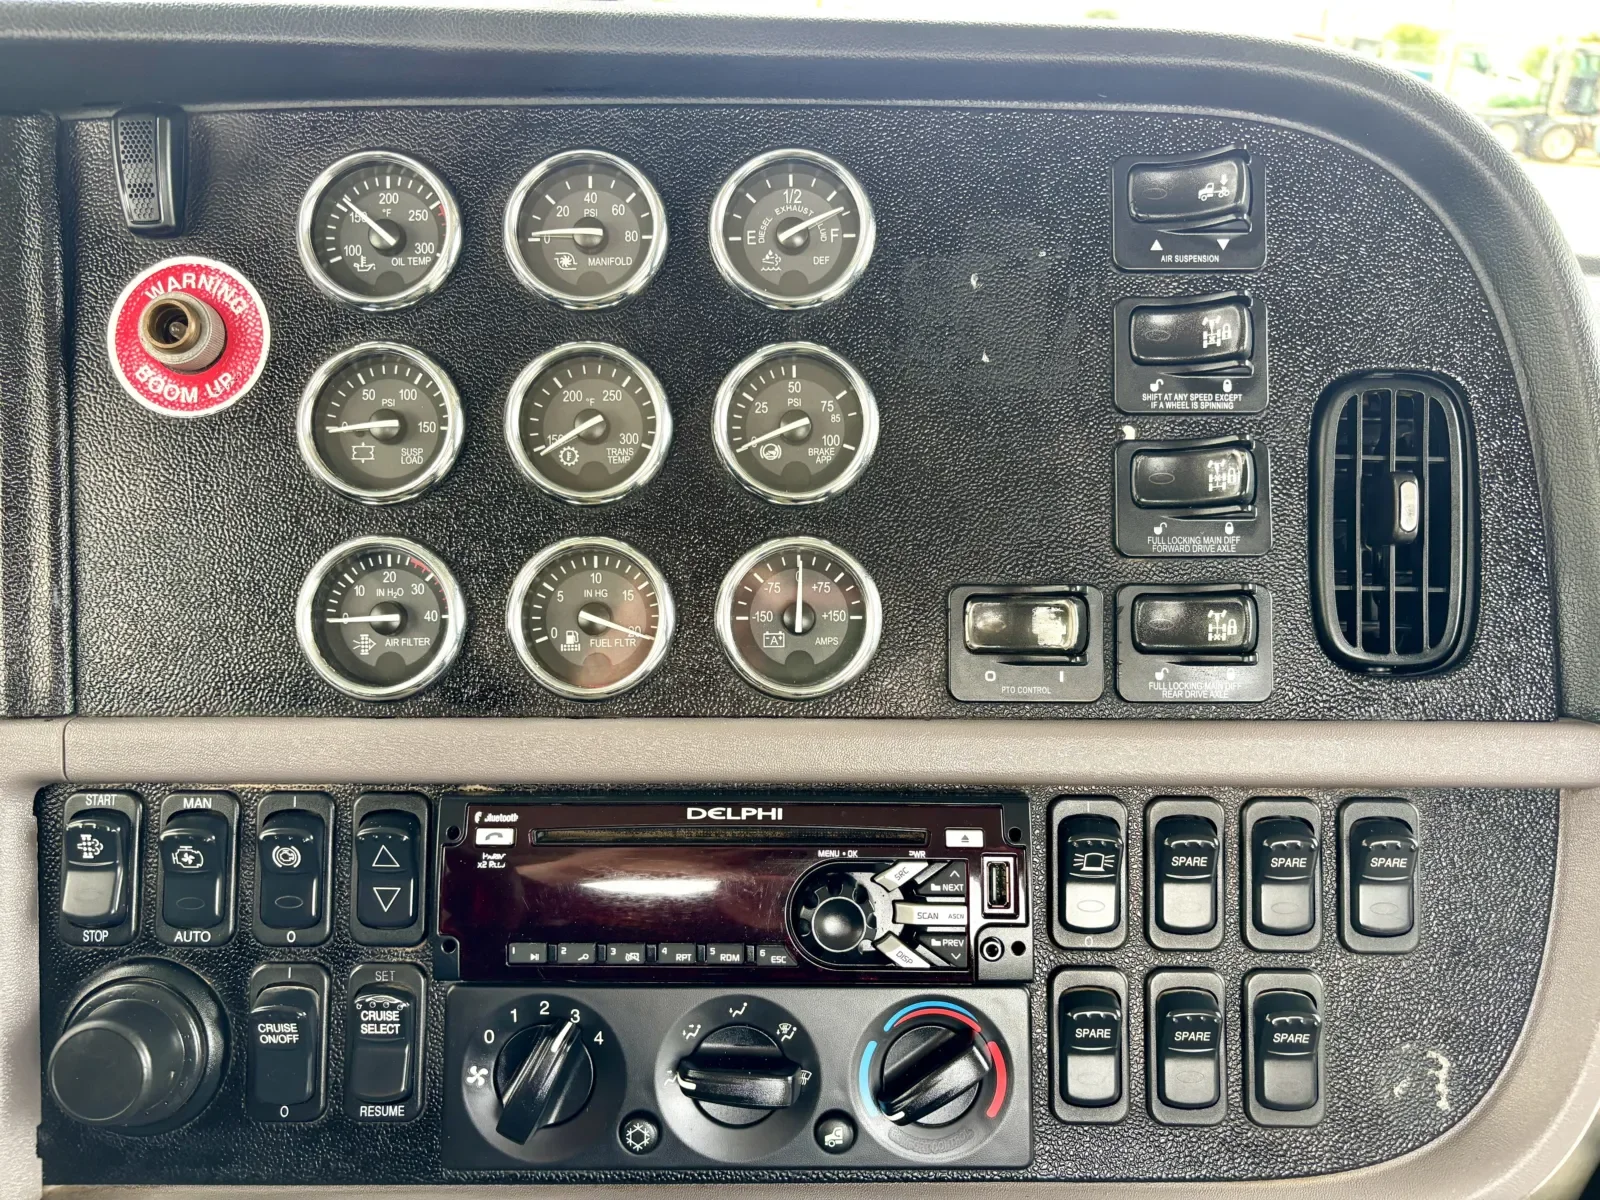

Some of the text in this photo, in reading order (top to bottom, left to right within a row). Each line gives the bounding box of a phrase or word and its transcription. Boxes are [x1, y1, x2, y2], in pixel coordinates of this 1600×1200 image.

[379, 193, 399, 205] 200
[584, 192, 597, 203] 40
[783, 189, 802, 204] 1/2
[556, 206, 570, 217] 20
[583, 209, 598, 217] PSI
[611, 204, 625, 216] 60
[408, 210, 429, 222] 250
[758, 204, 827, 244] DIESEL EXHAUST LUID
[625, 231, 638, 242] 80
[747, 230, 756, 245] E
[830, 228, 839, 243] F
[344, 245, 362, 257] 100
[414, 243, 435, 255] 300
[391, 257, 431, 266] OIL TEMP
[588, 257, 632, 267] MANIFOLD
[813, 256, 830, 265] DEF
[1161, 255, 1219, 263] AIR SUSPENSION
[144, 272, 250, 316] WARNING
[136, 364, 235, 403] BOOM UP
[788, 382, 801, 393] 50
[362, 389, 375, 400] 50
[399, 389, 418, 400] 100
[563, 390, 583, 402] 200
[602, 390, 622, 402] 250
[1215, 394, 1243, 402] EXCEPT
[381, 399, 395, 407] PSI
[755, 402, 769, 414] 25
[787, 398, 802, 407] PSI
[821, 401, 834, 412] 75
[830, 414, 841, 423] 85
[418, 422, 437, 433] 150
[619, 433, 639, 445] 300
[821, 434, 840, 446] 100
[401, 448, 423, 456] SUSP
[606, 448, 634, 456] TRANS
[808, 448, 835, 456] BRAKE
[401, 456, 423, 464] LOAD
[607, 456, 631, 464] TEMP
[815, 456, 832, 464] APP
[1148, 536, 1241, 545] FULL LOCKING MAIN DIFF
[1152, 545, 1236, 553] FORWARD DRIVE AXLE
[383, 571, 396, 583] 20
[590, 572, 602, 584] 10
[354, 585, 365, 597] 10
[376, 588, 385, 597] IN
[411, 583, 425, 595] 30
[764, 582, 781, 593] -75
[812, 582, 831, 593] +75
[557, 591, 564, 602] 5
[584, 589, 608, 598] IN HG
[622, 589, 634, 601] 15
[424, 610, 438, 622] 40
[752, 611, 773, 622] -150
[821, 610, 846, 622] +150
[550, 627, 558, 638] 0
[385, 638, 431, 647] AIR FILTER
[590, 638, 636, 647] FUEL FLTR
[815, 637, 838, 646] AMPS
[1001, 686, 1051, 694] PTO CONTROL
[1149, 682, 1242, 690] FULL LOCKING MAIN DIFF
[1162, 691, 1229, 699] REAR DRIVE AXLE
[85, 794, 117, 806] START
[183, 798, 212, 809] MAN
[687, 807, 783, 820] DELPHI
[818, 850, 858, 858] MENU OK
[1171, 856, 1208, 867] SPARE
[1270, 857, 1307, 868] SPARE
[1370, 857, 1408, 868] SPARE
[894, 867, 909, 881] SRC
[917, 912, 939, 920] SCAN
[83, 930, 109, 943] STOP
[174, 931, 211, 942] AUTO
[942, 939, 964, 947] PREV
[512, 947, 515, 955] 1
[561, 947, 567, 955] 2
[610, 948, 617, 956] 3
[661, 947, 668, 955] 4
[710, 947, 716, 955] 5
[759, 949, 766, 957] 6
[896, 950, 913, 964] DISP
[375, 970, 396, 982] SET
[539, 1001, 550, 1015] 2
[361, 1011, 400, 1021] CRUISE
[510, 1009, 517, 1022] 1
[570, 1009, 580, 1023] 3
[258, 1024, 298, 1033] CRUISE
[360, 1024, 401, 1035] SELECT
[1075, 1029, 1111, 1039] SPARE
[260, 1035, 299, 1044] ON/OFF
[484, 1030, 494, 1044] 0
[594, 1031, 604, 1045] 4
[1174, 1031, 1211, 1042] SPARE
[1272, 1033, 1310, 1044] SPARE
[360, 1106, 405, 1117] RESUME
